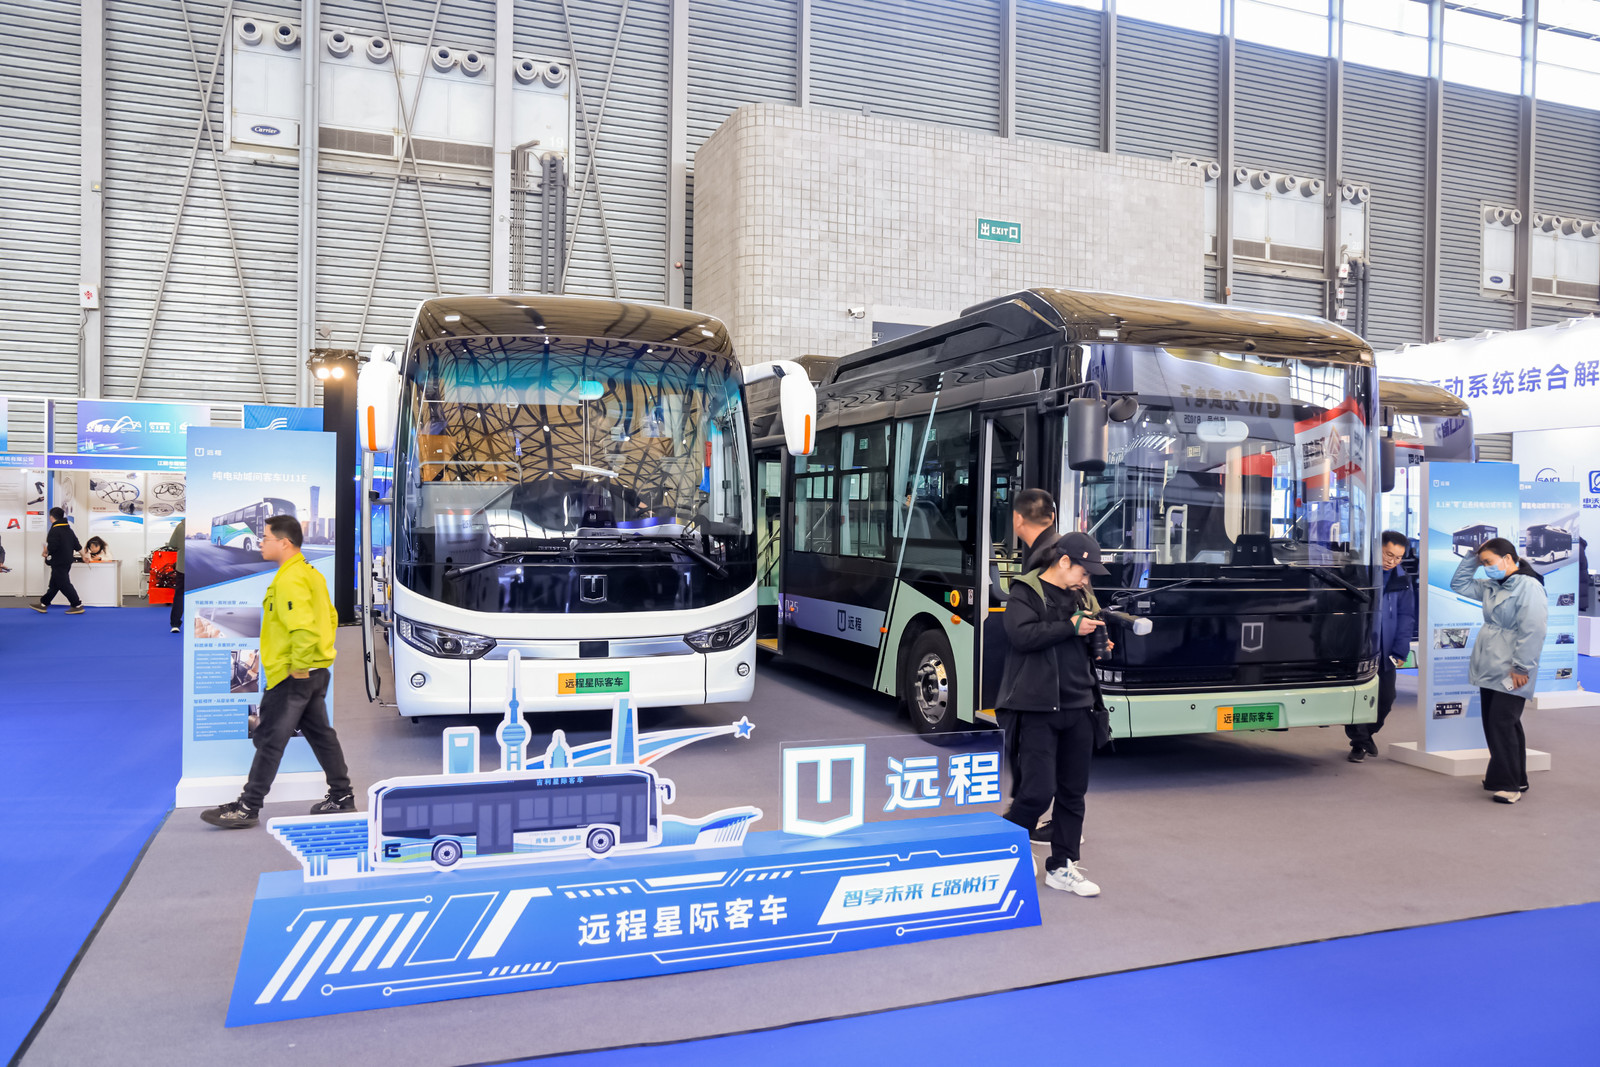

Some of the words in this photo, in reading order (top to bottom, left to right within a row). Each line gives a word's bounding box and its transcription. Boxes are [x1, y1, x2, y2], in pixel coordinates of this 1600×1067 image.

[254, 126, 278, 134] Carrier
[980, 222, 990, 236] 出
[991, 226, 1009, 236] EXIT
[1009, 226, 1018, 239] 口
[847, 615, 862, 632] 远程
[565, 677, 624, 689] 远程星际客车
[1223, 711, 1274, 724] 远程星际客车
[883, 751, 1001, 812] 远程
[843, 883, 924, 908] 智享未来
[931, 874, 1001, 898] E路悦行
[578, 894, 788, 947] 远程星际客车
